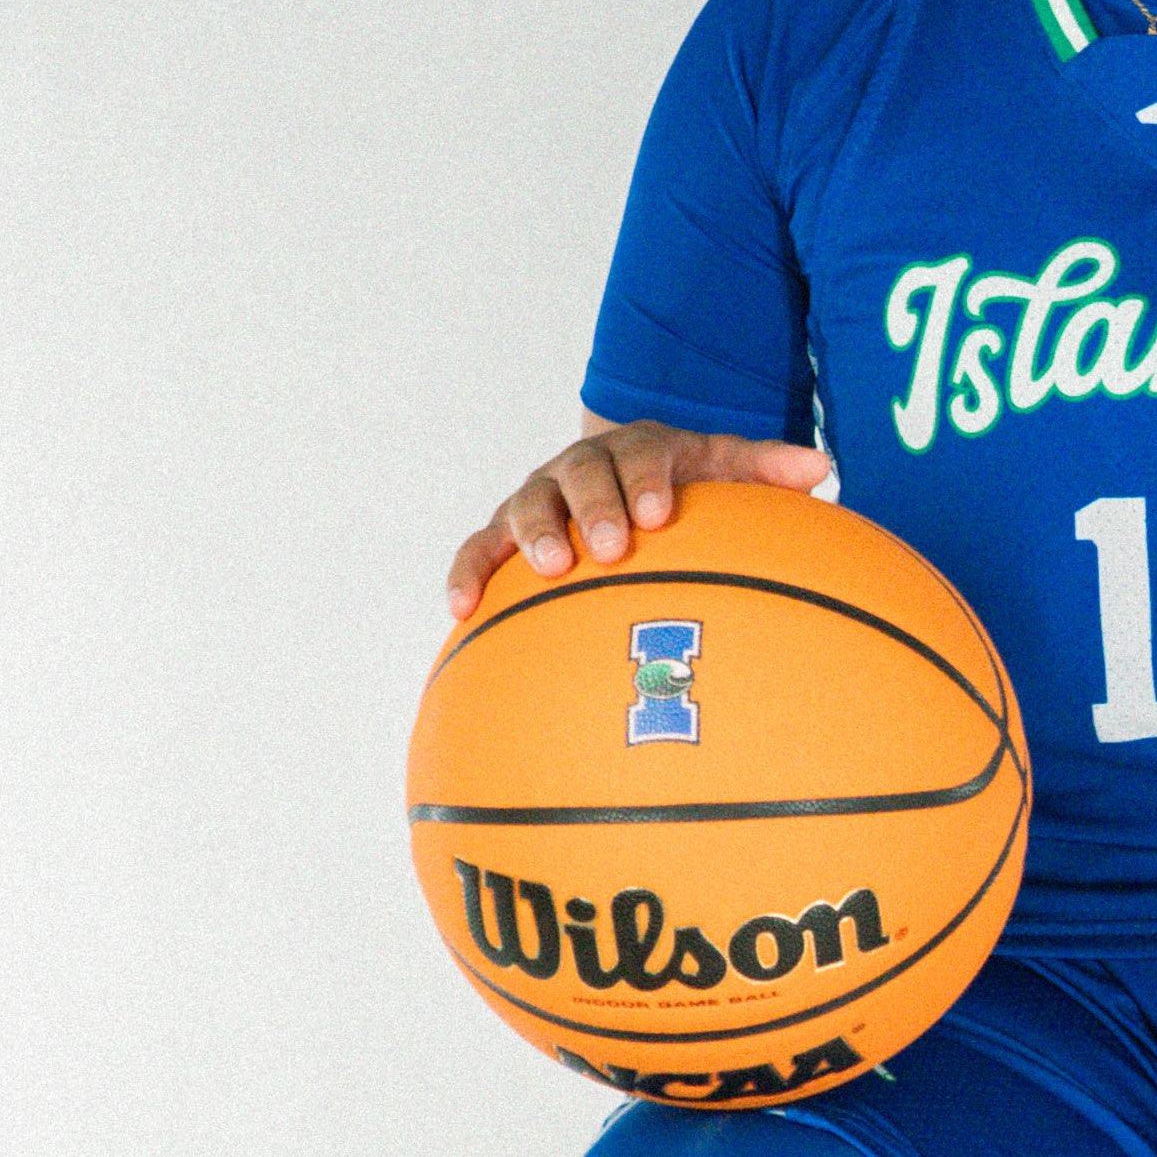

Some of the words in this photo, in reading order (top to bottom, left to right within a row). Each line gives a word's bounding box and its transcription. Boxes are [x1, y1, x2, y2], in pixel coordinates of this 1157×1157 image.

[453, 856, 890, 991] Wilson
[572, 996, 649, 1009] INDOOR
[658, 998, 720, 1009] GAME
[728, 991, 783, 1004] BALL
